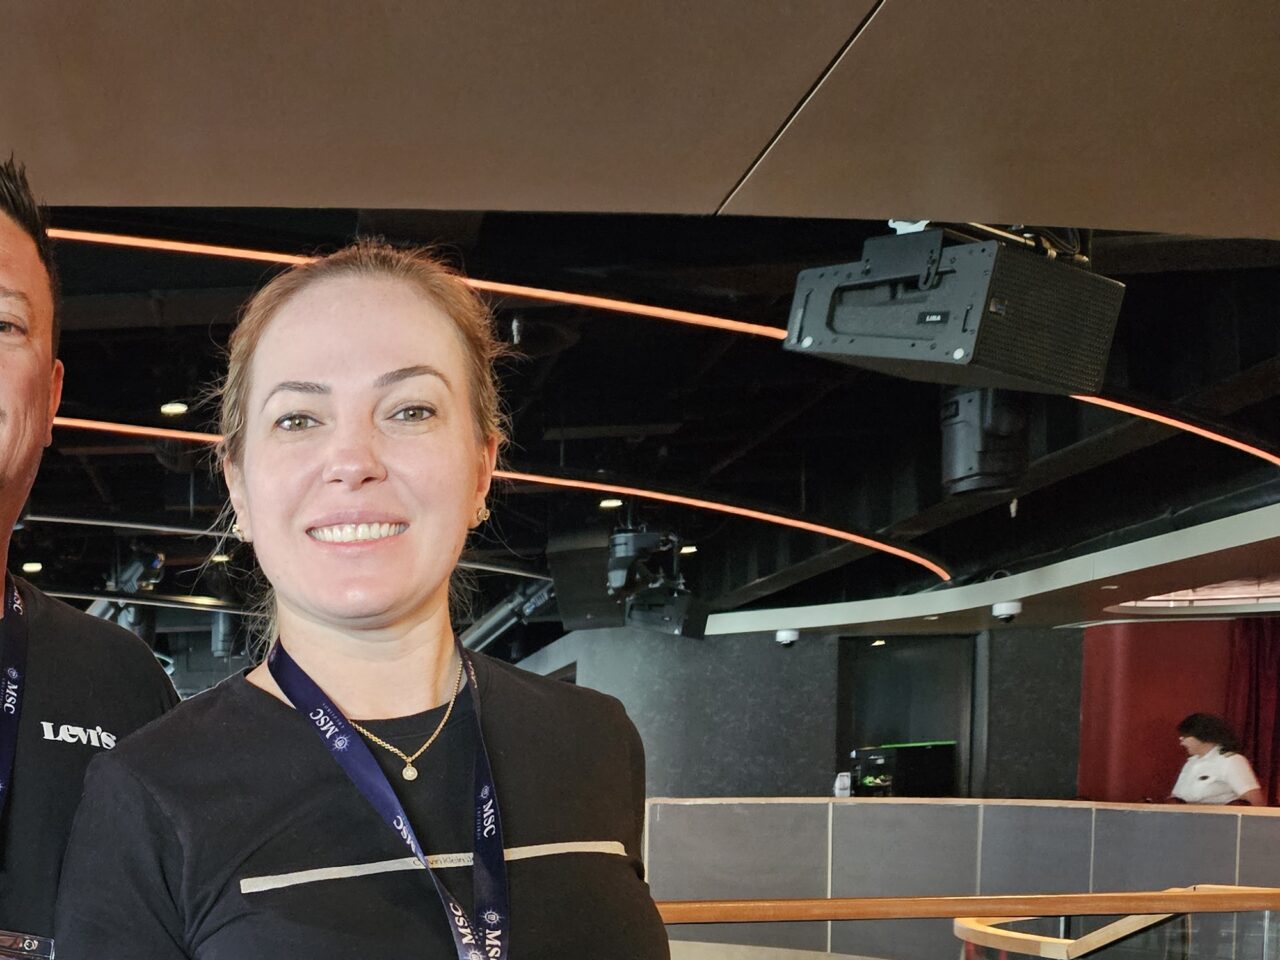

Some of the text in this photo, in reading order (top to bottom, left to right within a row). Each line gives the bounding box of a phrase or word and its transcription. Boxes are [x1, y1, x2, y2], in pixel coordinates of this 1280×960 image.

[4, 681, 18, 714] MSC
[40, 721, 117, 750] Levi's
[309, 708, 339, 739] MSC
[483, 798, 496, 838] MSC
[449, 903, 475, 945] MSC
